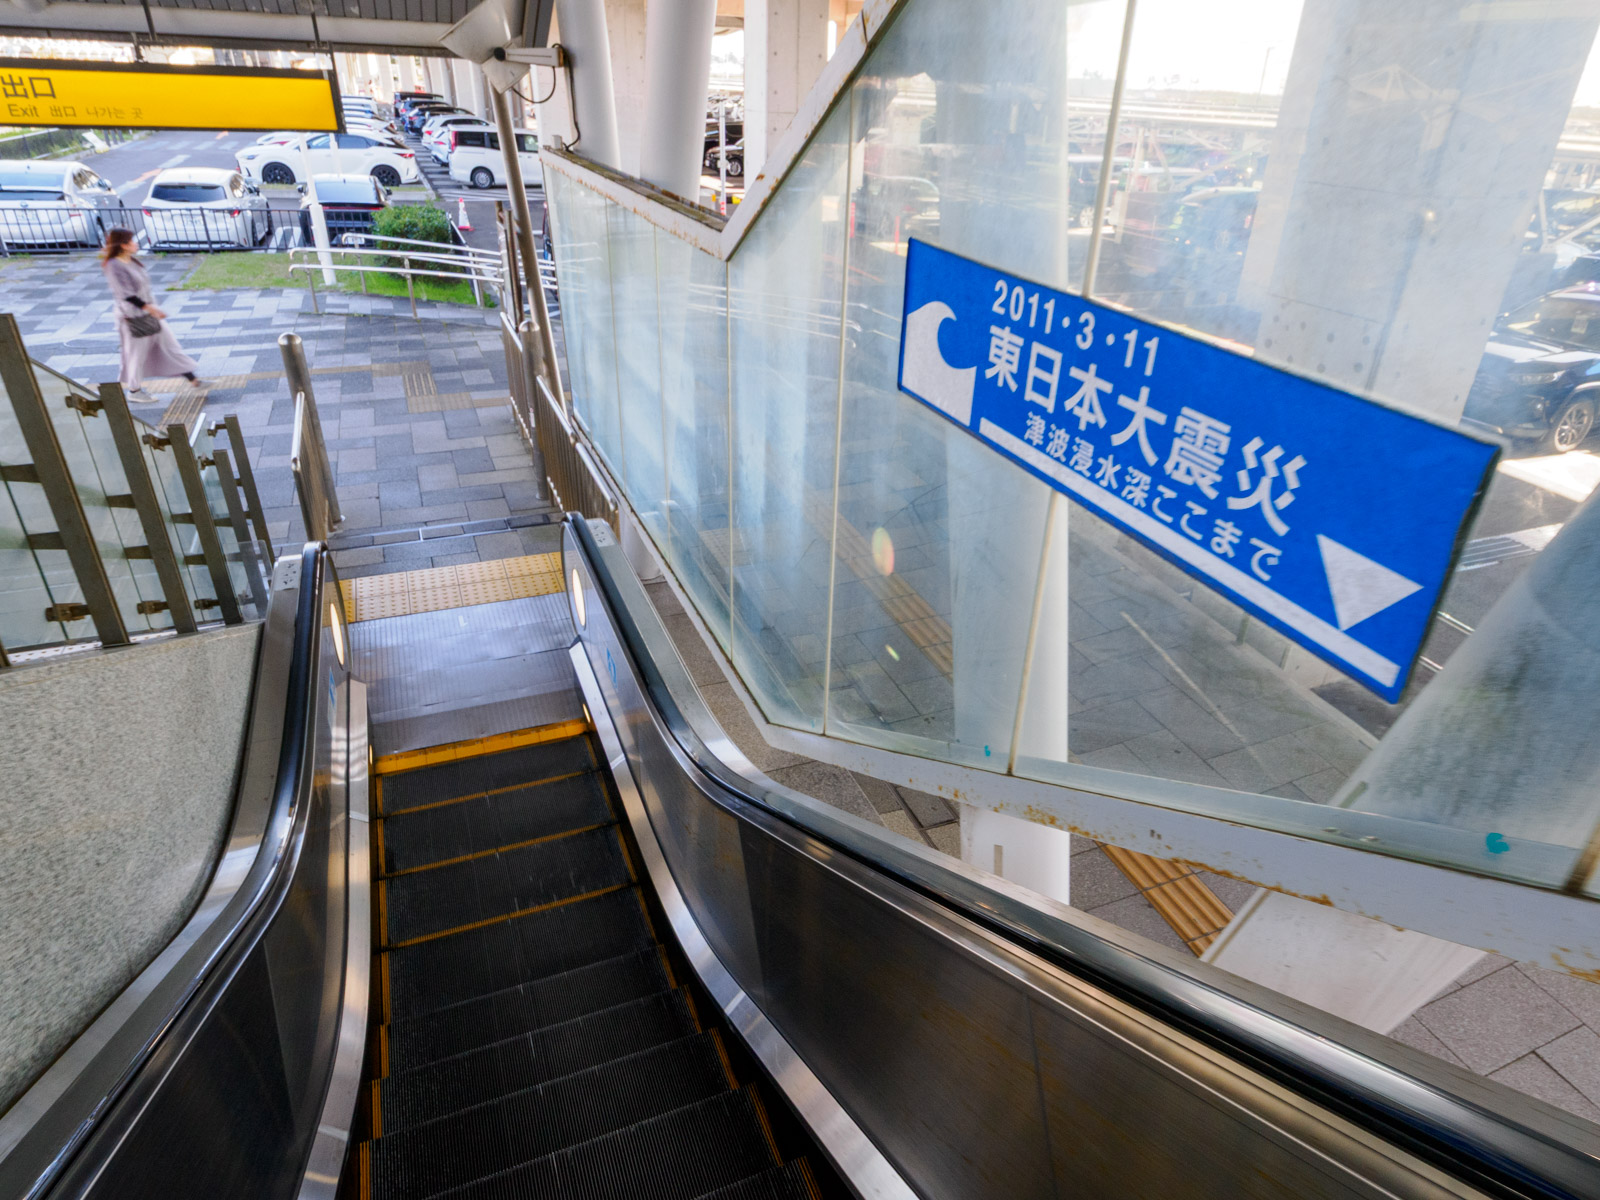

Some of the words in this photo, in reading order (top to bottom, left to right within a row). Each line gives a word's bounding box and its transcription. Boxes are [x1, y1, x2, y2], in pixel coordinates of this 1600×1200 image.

[0, 74, 56, 99] 出口
[7, 103, 39, 118] Exit
[49, 105, 77, 118] 出口
[86, 106, 125, 119] 나가는
[984, 325, 1308, 537] 東日本大震災
[1024, 411, 1283, 581] 津波浸水深ここまで
